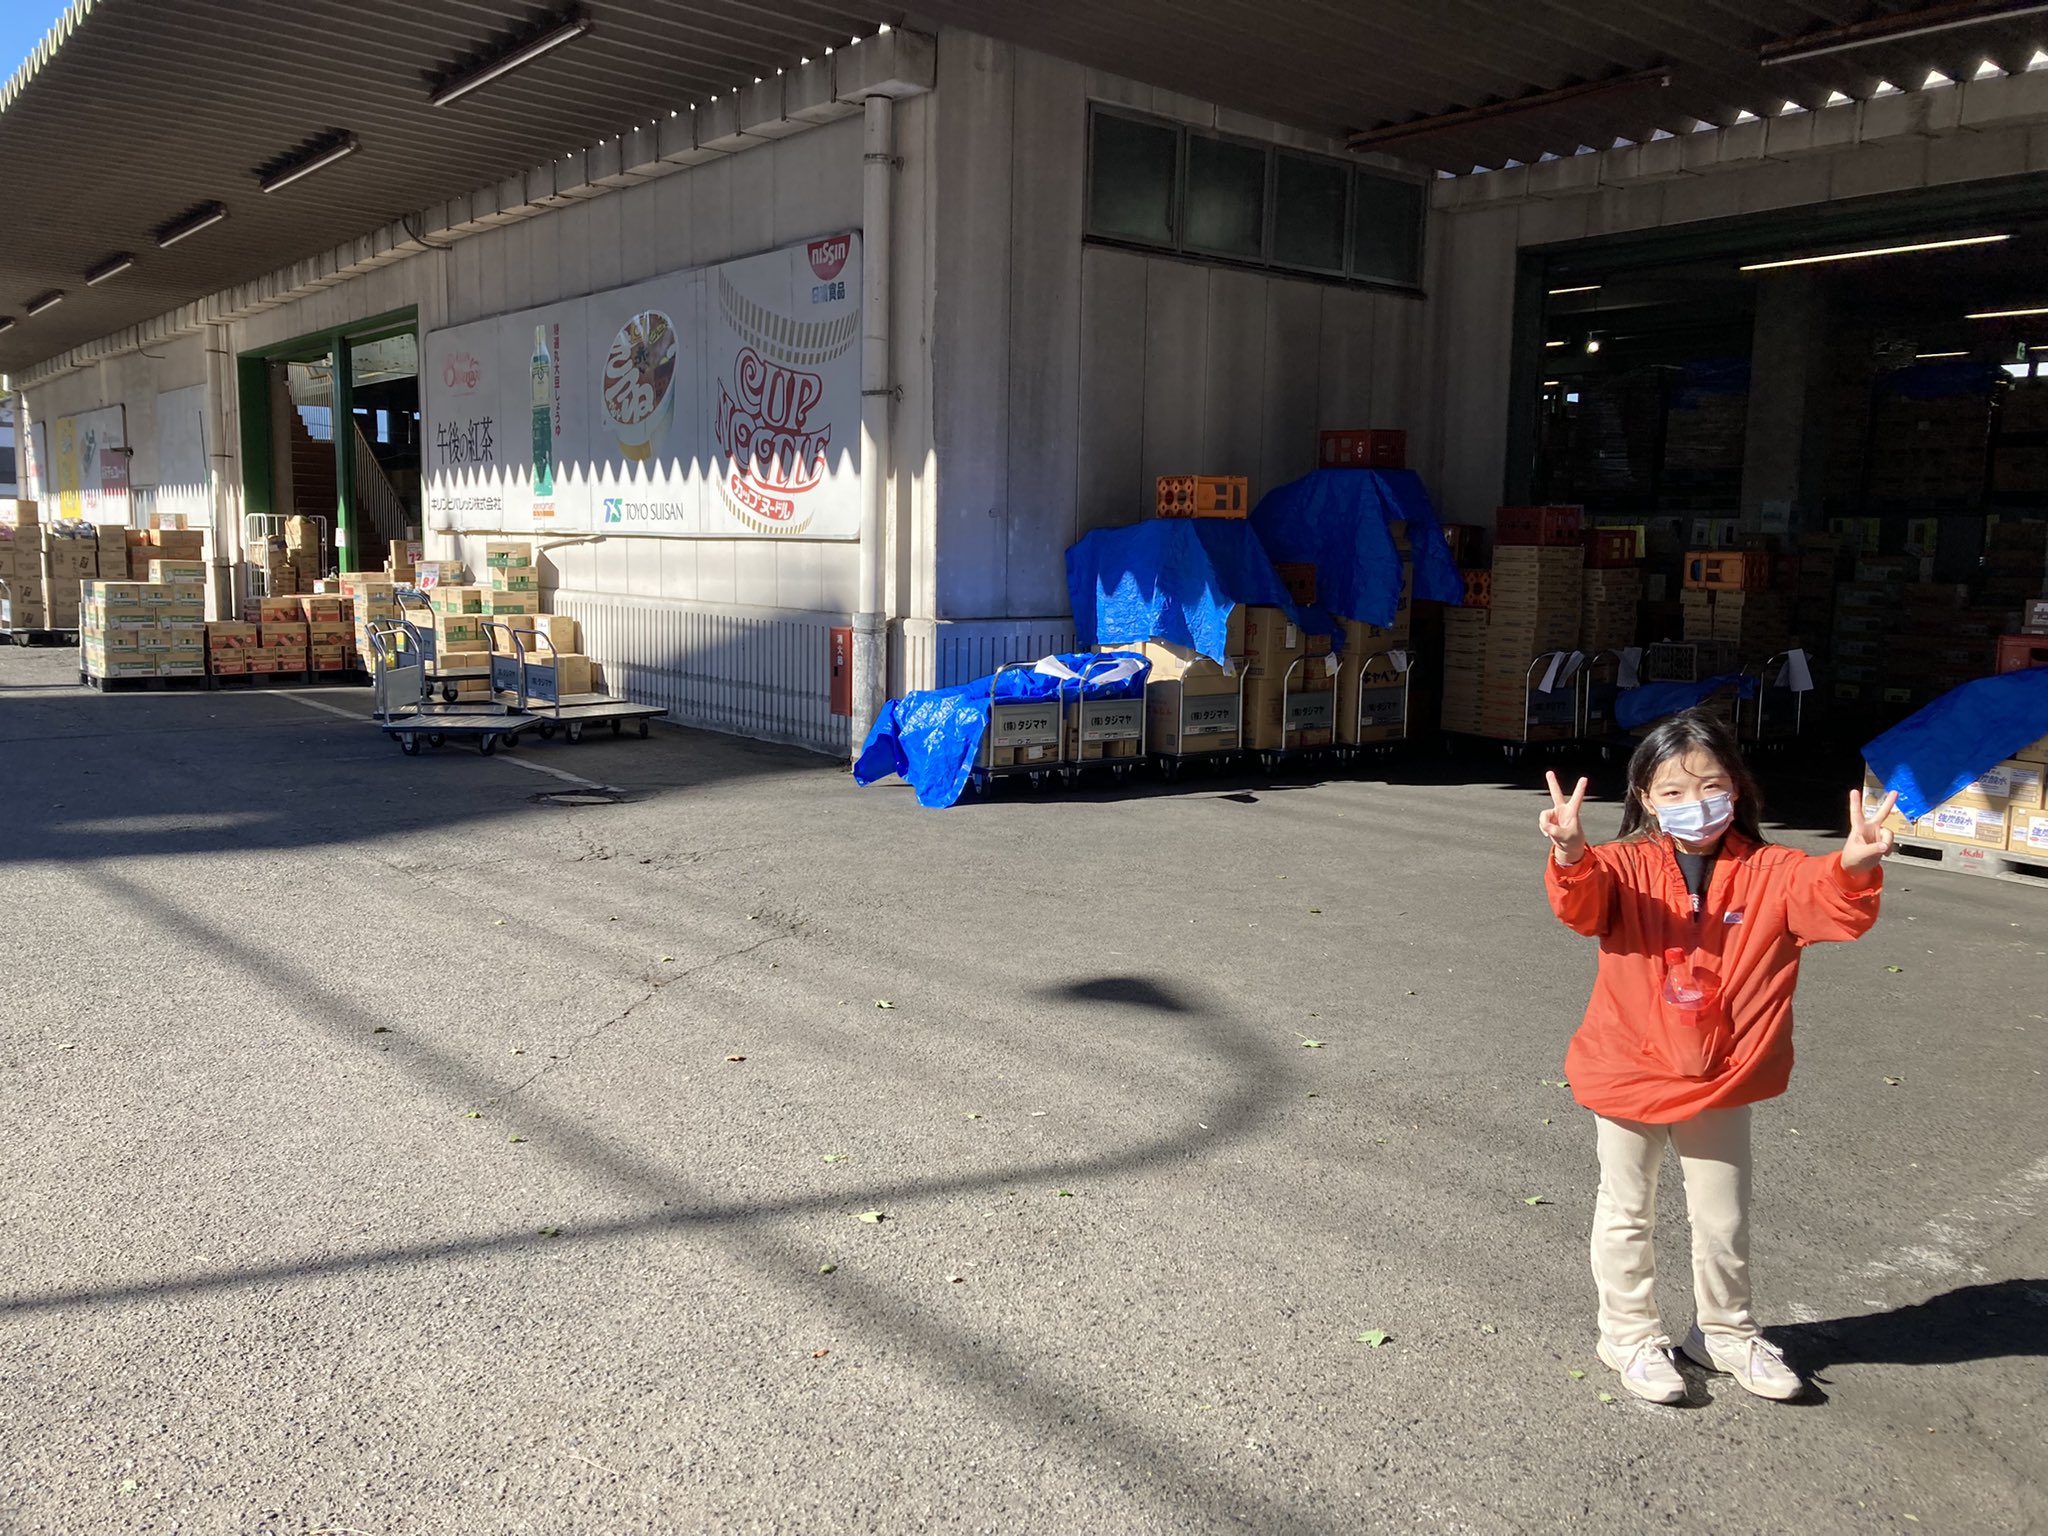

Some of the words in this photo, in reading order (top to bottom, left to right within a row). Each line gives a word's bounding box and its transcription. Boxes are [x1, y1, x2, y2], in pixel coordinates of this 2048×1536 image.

[734, 347, 823, 432] CUP
[436, 415, 494, 466] 午後の紅茶
[715, 377, 832, 492] NOODLE
[625, 503, 649, 521] TOYO
[650, 503, 684, 521] SUISAN
[733, 478, 792, 520] カップヌードル
